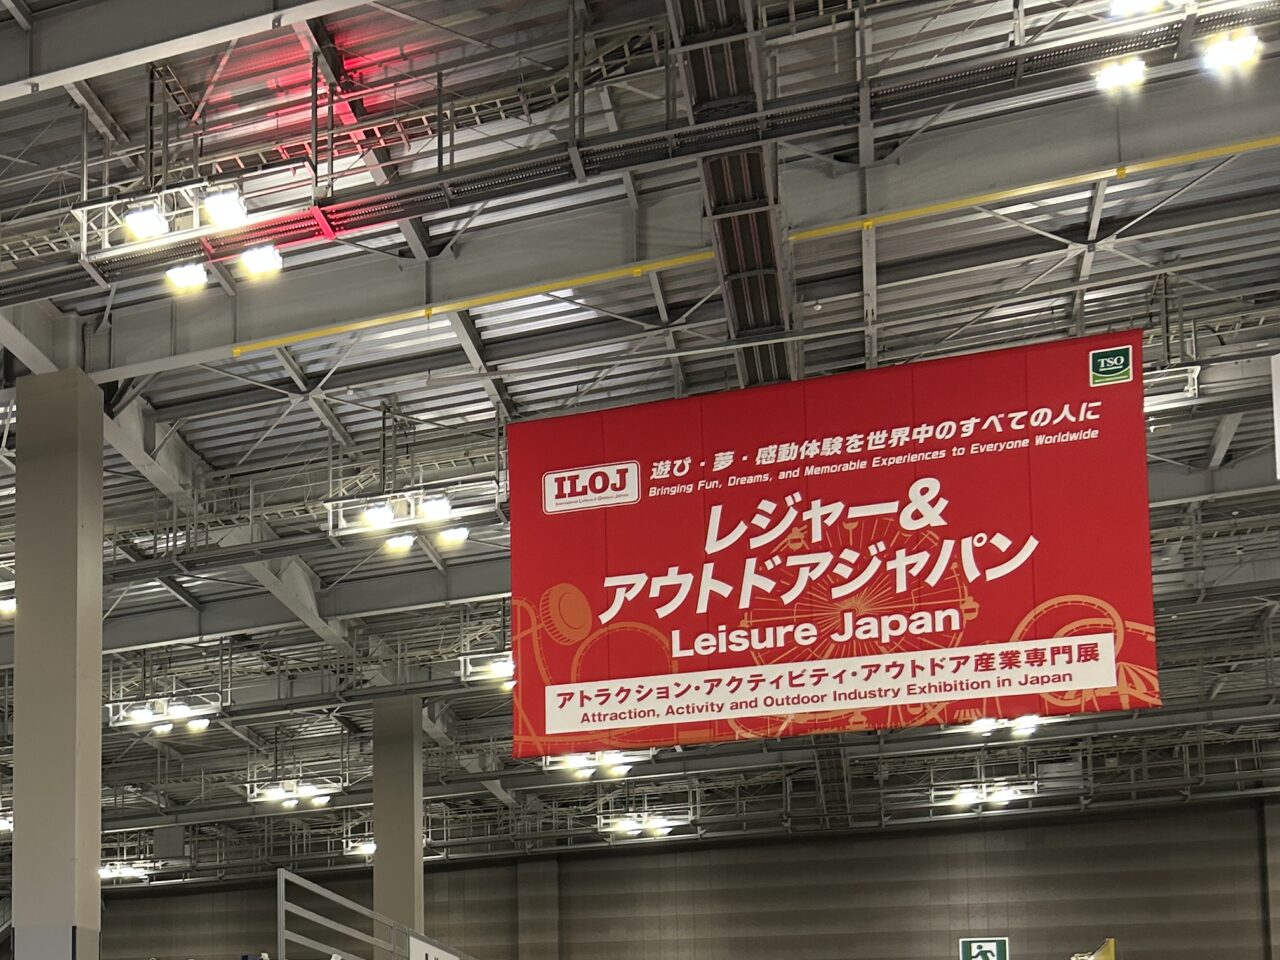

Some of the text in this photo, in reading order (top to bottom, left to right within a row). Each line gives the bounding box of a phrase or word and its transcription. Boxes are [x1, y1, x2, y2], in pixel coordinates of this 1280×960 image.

[1097, 355, 1125, 369] TSO
[554, 468, 629, 500] ILOJ
[648, 428, 1099, 498] Bringing Fun, Dreams, and Memorable Experiences to Everyone Worldwide
[598, 532, 1039, 625] アウトドアジャパン
[671, 607, 960, 658] Leisure Japan
[580, 671, 1073, 724] Attraction, Activity and Outdoor Industry Exhibition in Japan
